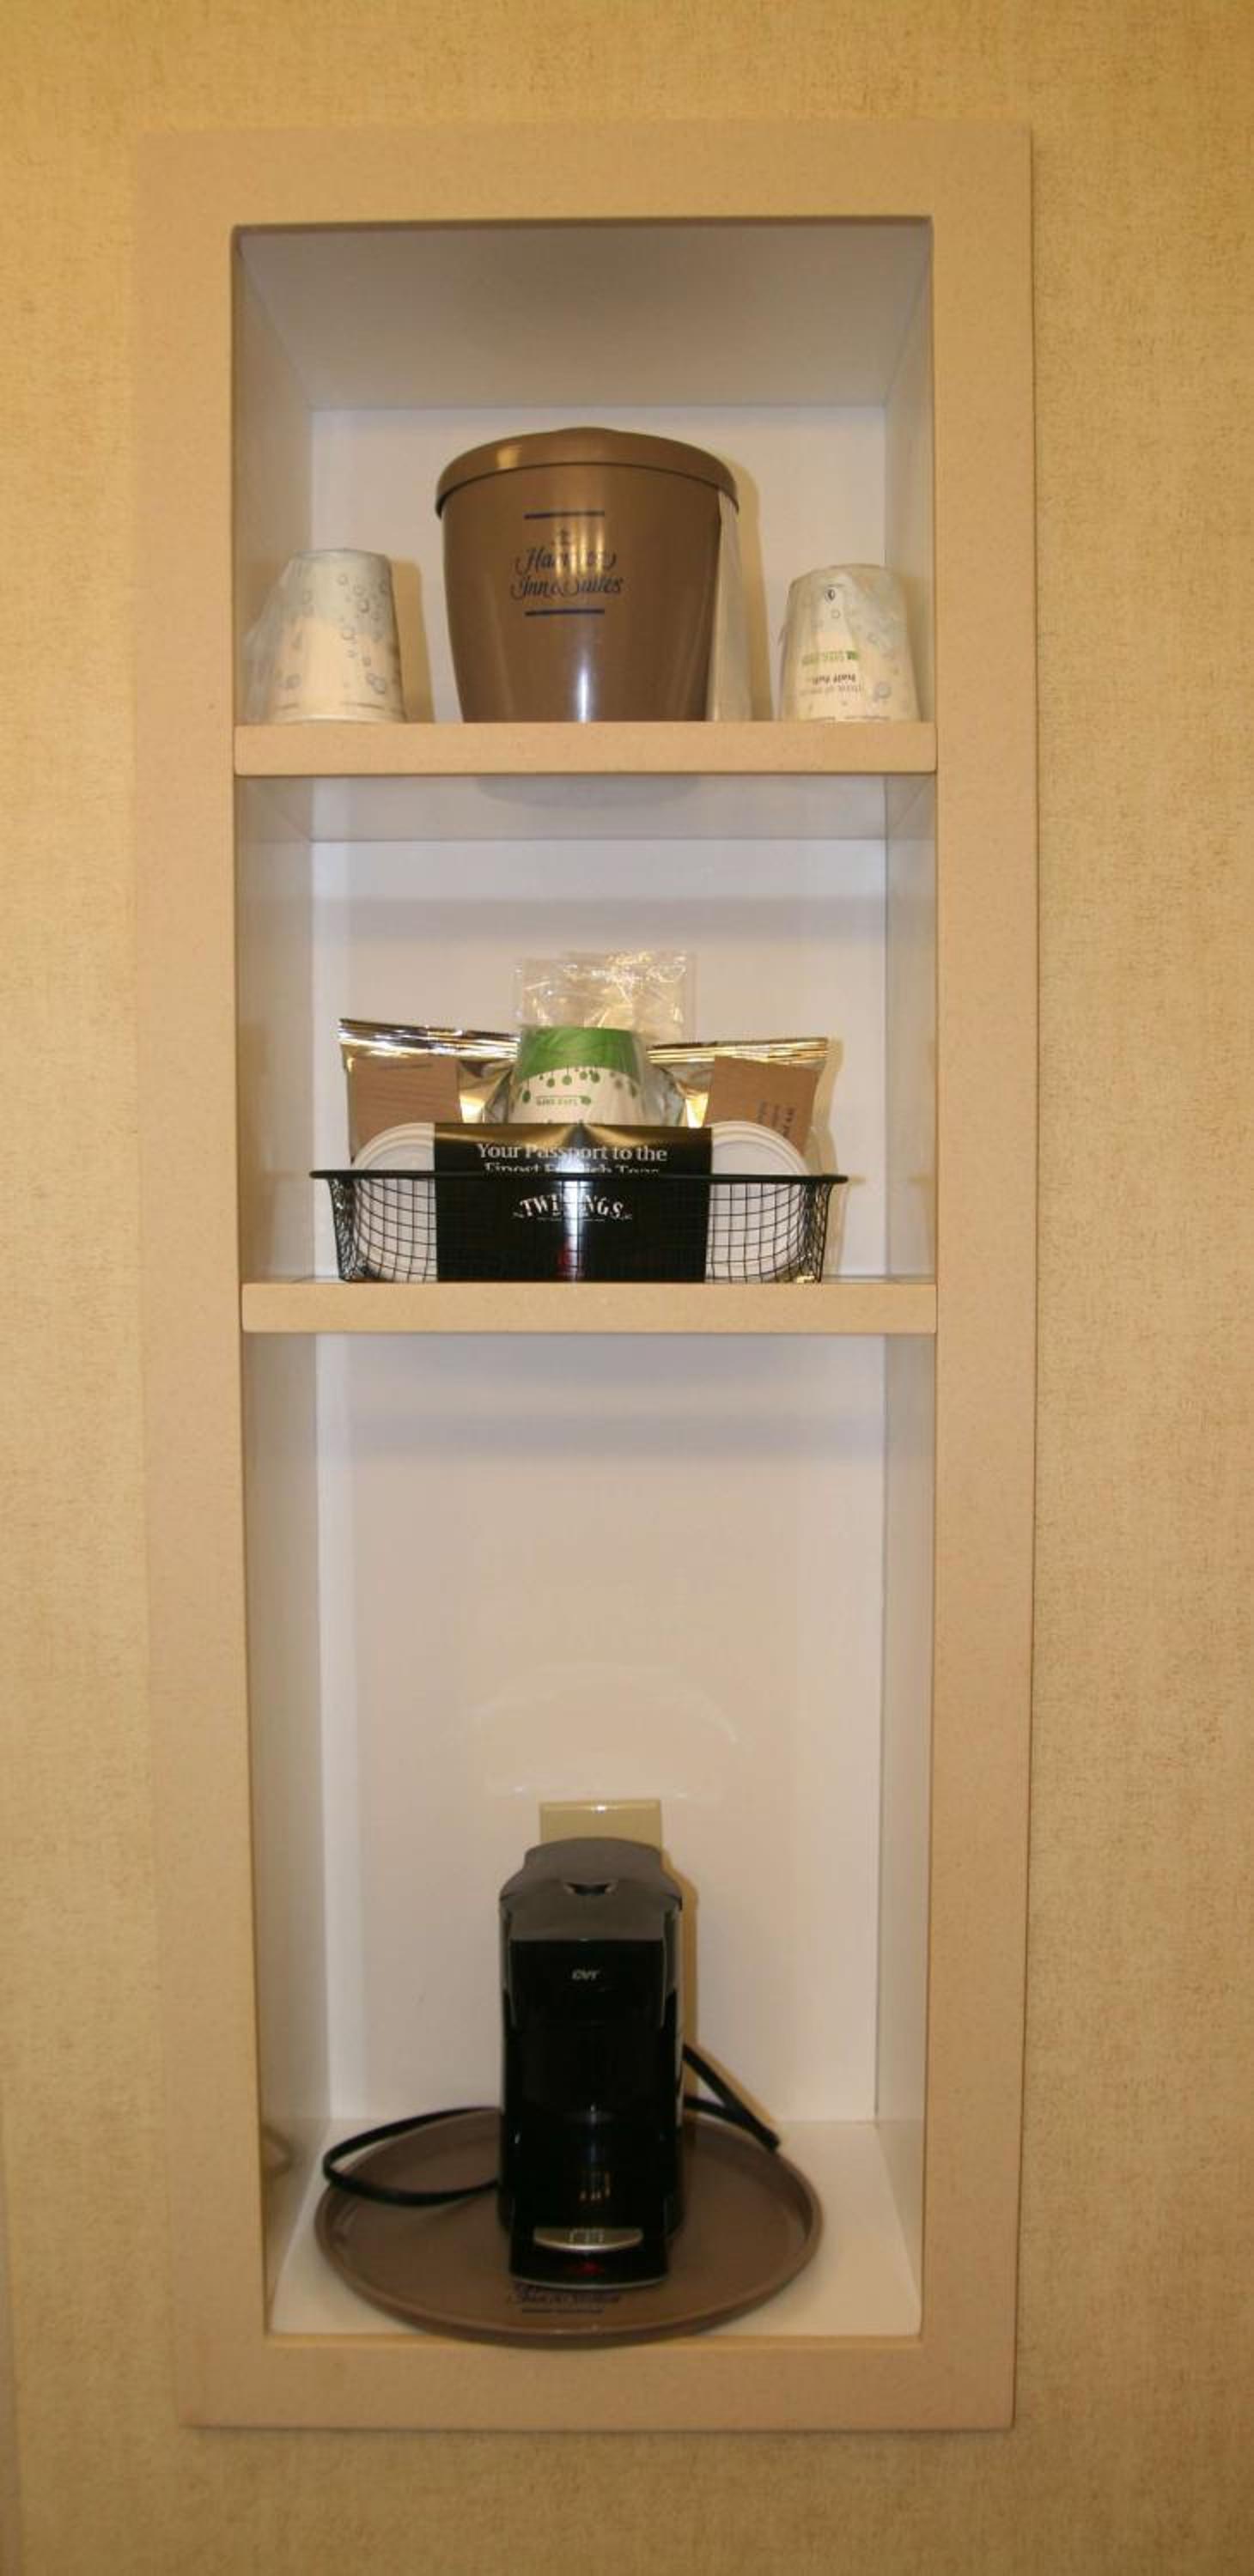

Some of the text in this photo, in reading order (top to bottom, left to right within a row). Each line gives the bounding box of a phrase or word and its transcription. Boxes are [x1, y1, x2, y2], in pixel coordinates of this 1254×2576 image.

[477, 1143, 667, 1161] Your Passport to the
[519, 1193, 624, 1219] TWINGS
